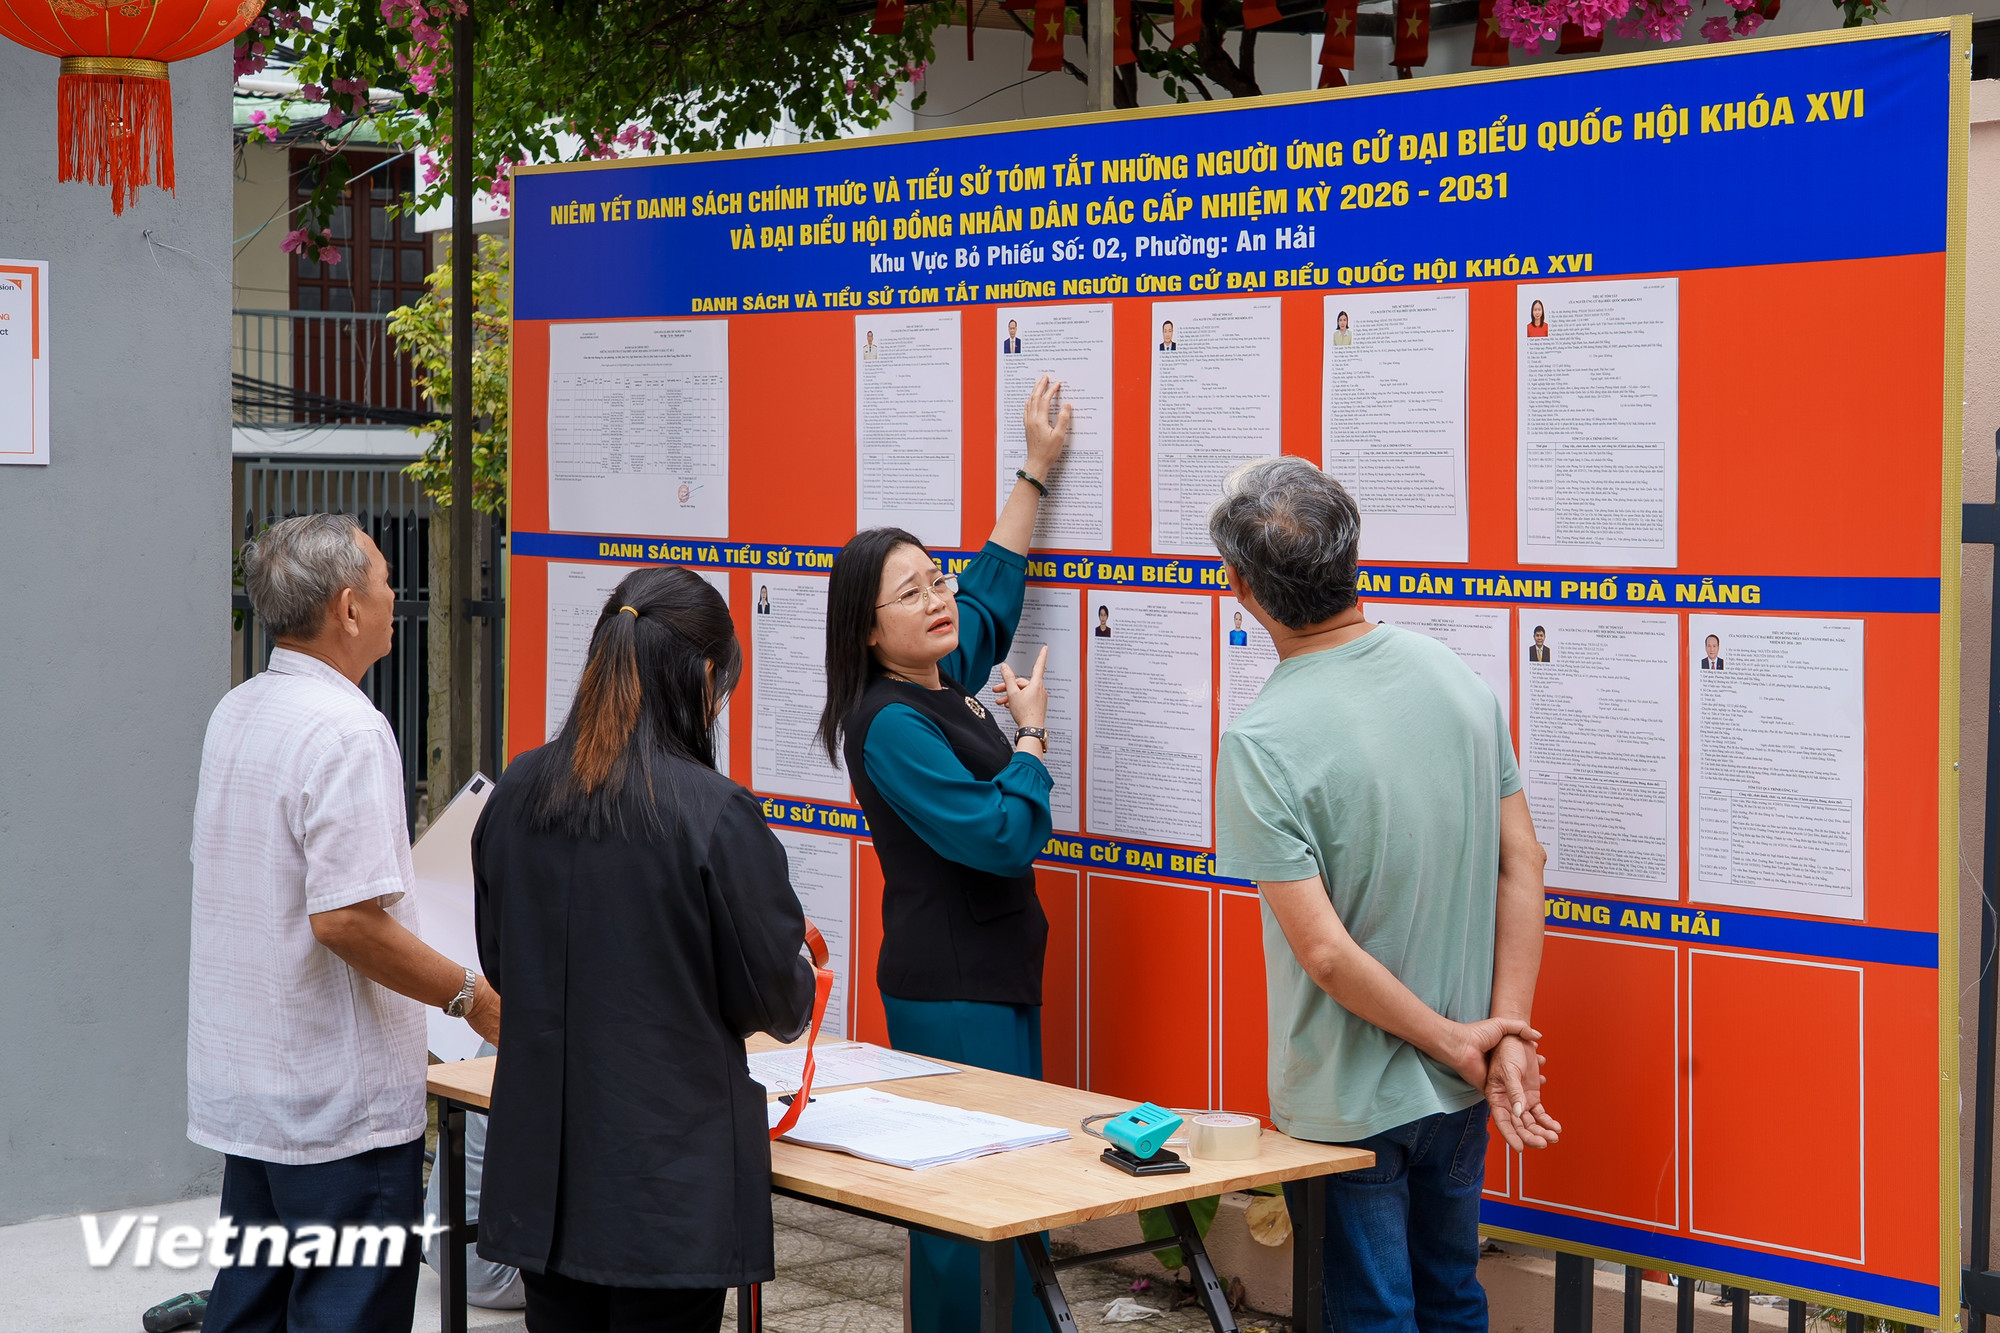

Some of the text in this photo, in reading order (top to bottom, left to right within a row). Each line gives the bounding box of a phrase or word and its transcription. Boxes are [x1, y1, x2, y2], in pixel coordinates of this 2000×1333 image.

[551, 88, 1864, 225] NIÊM YẾT DANH SÁCH CHÍNH THỨC VÀ TIỂU SỬ TÓM TẮT NHỮNG NGƯỜI ỨNG CỬ ĐẠI BIỂU QUỐC HỘI KHÓA XVI
[731, 224, 756, 250] VÀ
[761, 225, 794, 252] ĐẠI
[800, 214, 847, 246] BIỂU
[853, 215, 887, 248] HỘI
[893, 210, 953, 240] ĐỒNG
[960, 205, 1023, 236] NHÂN
[1031, 203, 1078, 230] DÂN
[1087, 199, 1135, 226] CÁC
[1143, 193, 1193, 223] CẤP
[1202, 184, 1288, 221] NHIỆM
[1298, 181, 1332, 213] KỲ
[1341, 180, 1409, 210] 2026
[1439, 172, 1507, 203] 2031
[692, 253, 1593, 312] DANH SÁCH VÀ TIỂU SỬ TÓM TẮT NHỮNG NGƯỜI ỨNG CỬ ĐẠI BIỂU QUỐC HỘI KHÓA XVI
[870, 224, 1315, 275] Khu Vực Bỏ Phiếu Số: 02, Phường: An Hải
[599, 542, 1761, 603] DANH SÁCH VÀ TIỂU SỬ TÓM NG CỬ ĐẠI BIỂU HỘ ÂN DÂN THÀNH PHỐ ĐÀ NẴNG
[761, 798, 785, 819] ỂU
[790, 803, 816, 823] SỬ
[818, 808, 857, 829] TÓM
[1090, 842, 1122, 863] CỬ
[1126, 849, 1163, 871] ĐẠI
[1620, 909, 1661, 930] AN
[1671, 910, 1720, 937] HẢI
